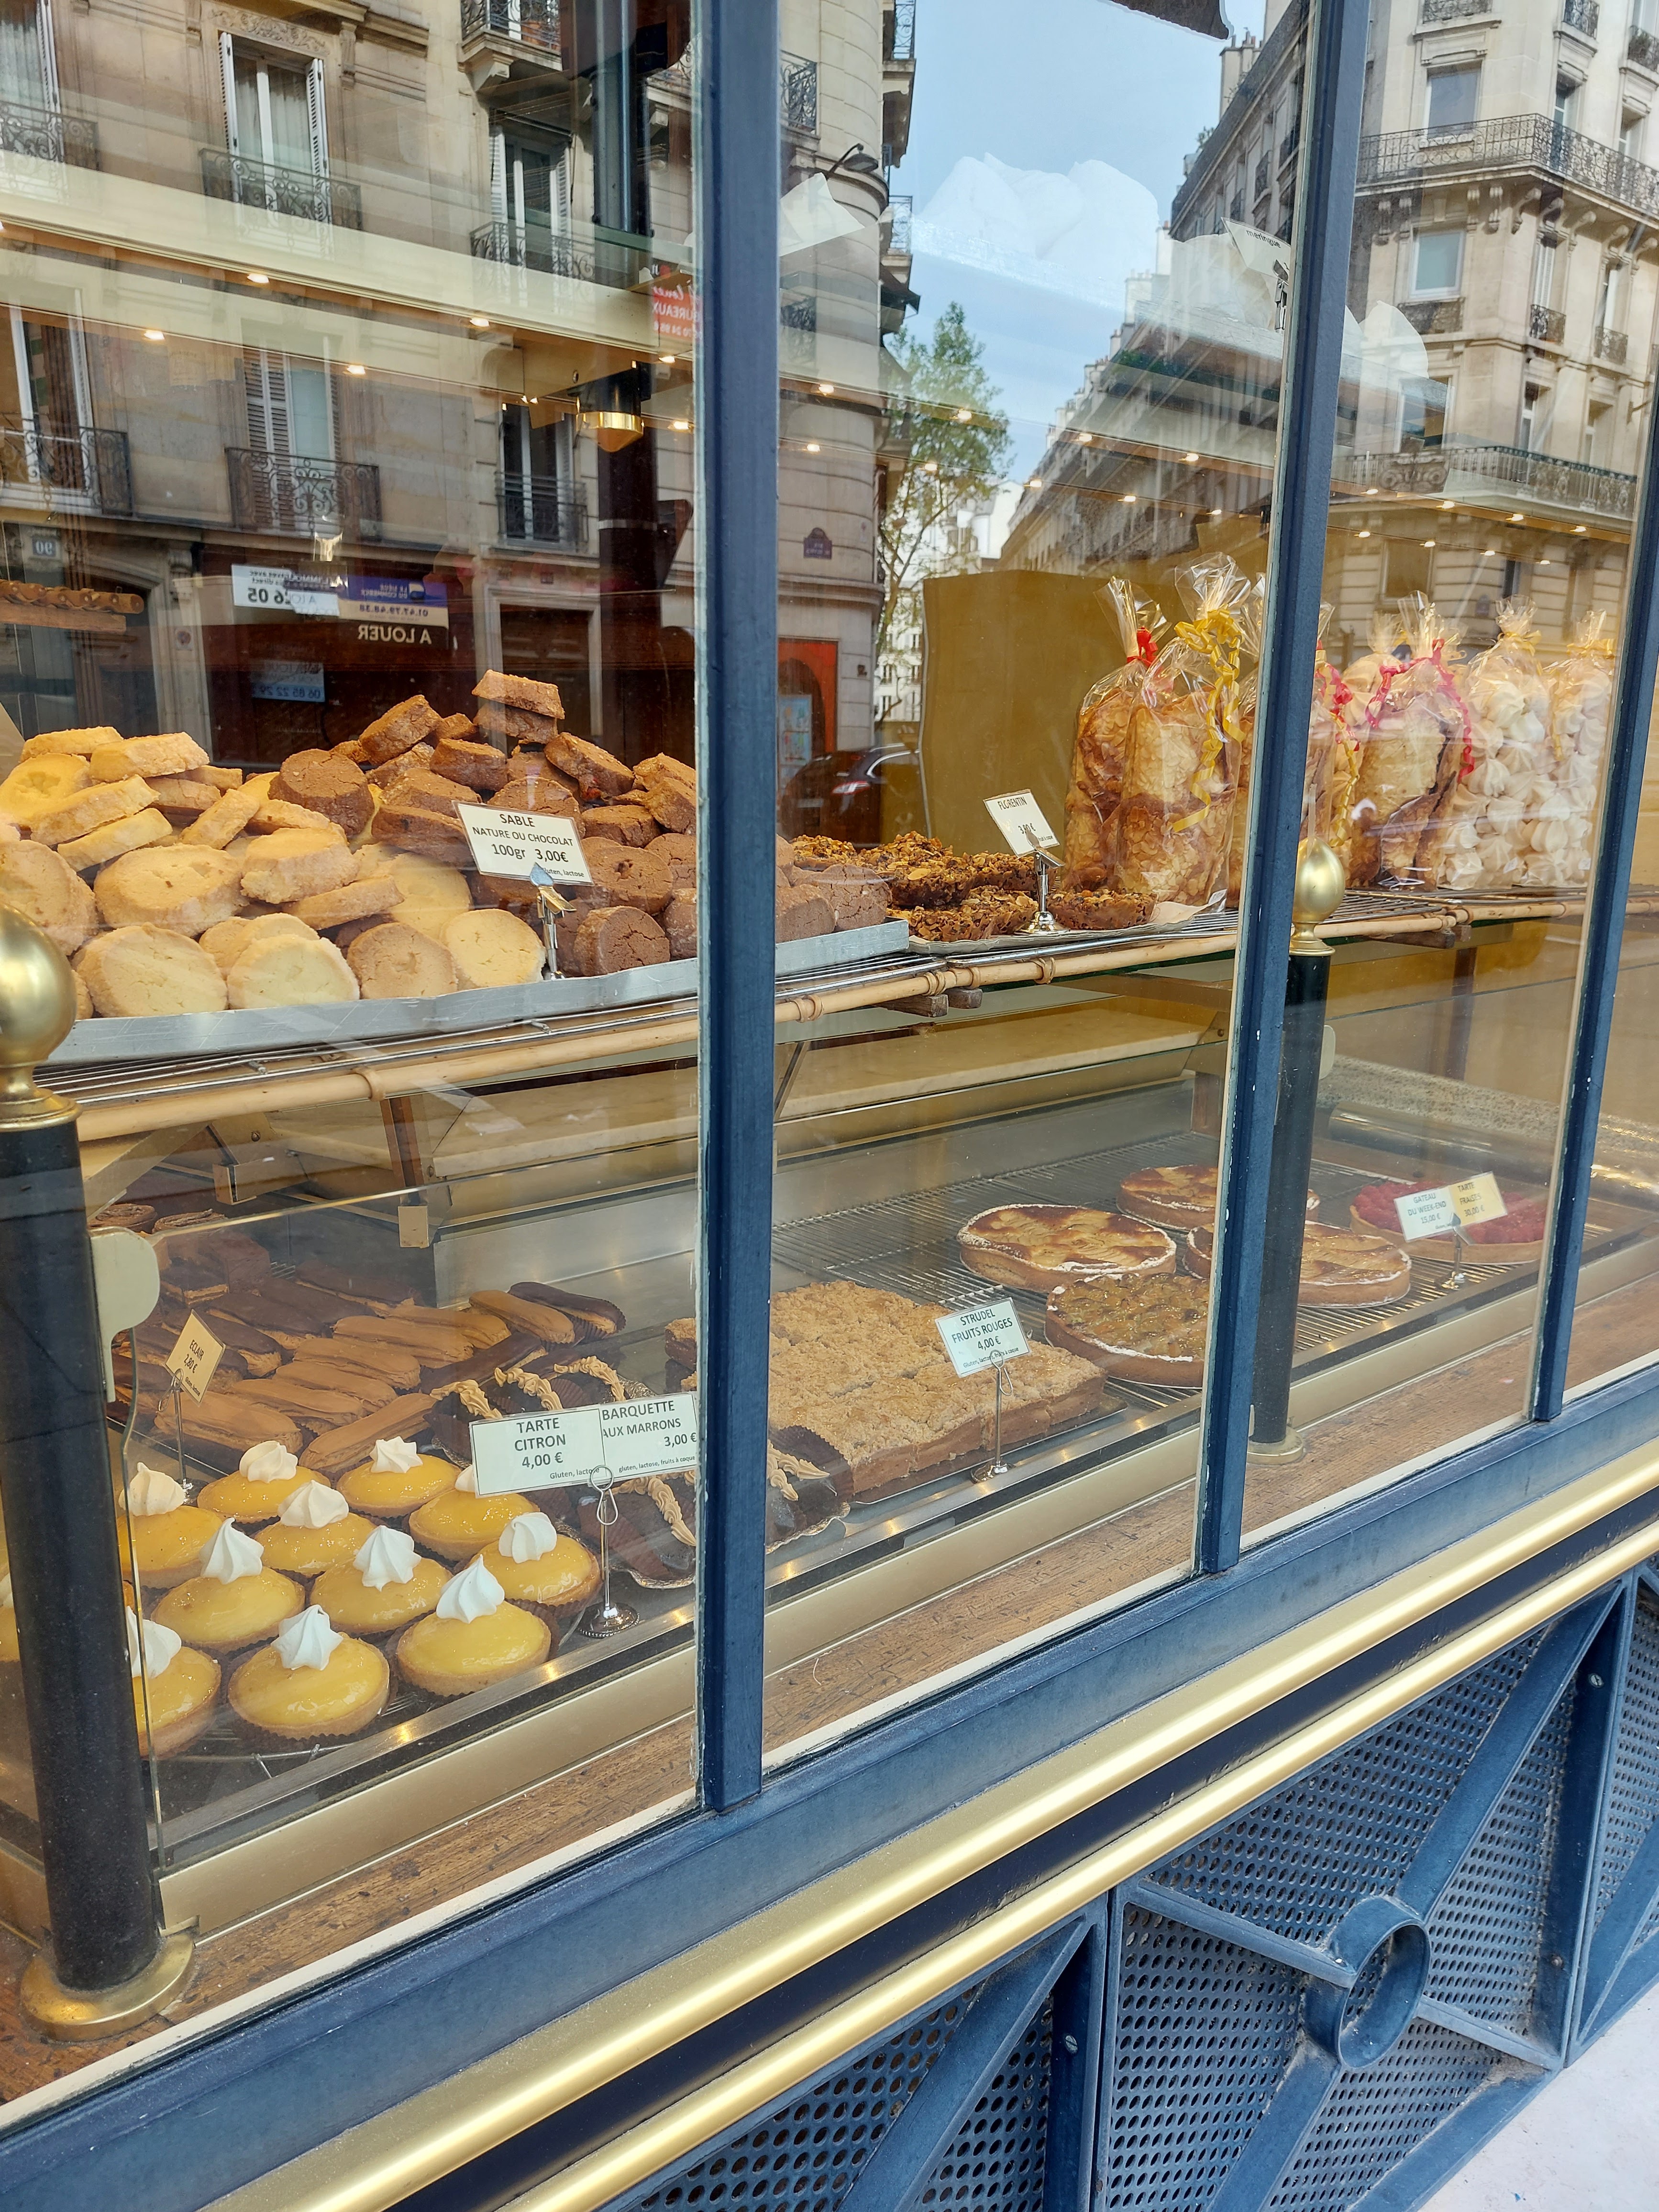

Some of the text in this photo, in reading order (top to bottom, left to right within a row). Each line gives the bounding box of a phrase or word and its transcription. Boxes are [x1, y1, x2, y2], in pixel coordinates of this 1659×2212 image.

[1246, 230, 1281, 248] meringue
[997, 796, 1027, 810] FLORENTIN
[499, 814, 535, 827] SABLE
[472, 827, 574, 846] NATURE OU CHOCOLAT
[491, 843, 569, 862] 100gr 3,00€
[1458, 1182, 1475, 1192] TARTE
[1413, 1193, 1436, 1204] GATEAU
[1459, 1193, 1482, 1205] FRAISES
[1407, 1201, 1447, 1216] DU WEEK-END
[960, 1308, 995, 1326] STRUDEL
[951, 1317, 1013, 1343] FRUITS ROUGES
[189, 1339, 204, 1361] ECLAIR
[978, 1336, 1001, 1350] 4,00 €
[184, 1353, 198, 1374] 2,80 €
[602, 1400, 675, 1420] BARQUETTE
[517, 1417, 560, 1434] TARTE
[603, 1418, 681, 1438] AUX MARRONS
[514, 1434, 566, 1452] CITRON
[664, 1432, 697, 1448] 3,00 €
[522, 1452, 564, 1470] 4,00 €
[619, 1464, 638, 1473] gluten,
[639, 1460, 660, 1469] lactose,
[576, 1468, 600, 1476] lactoe
